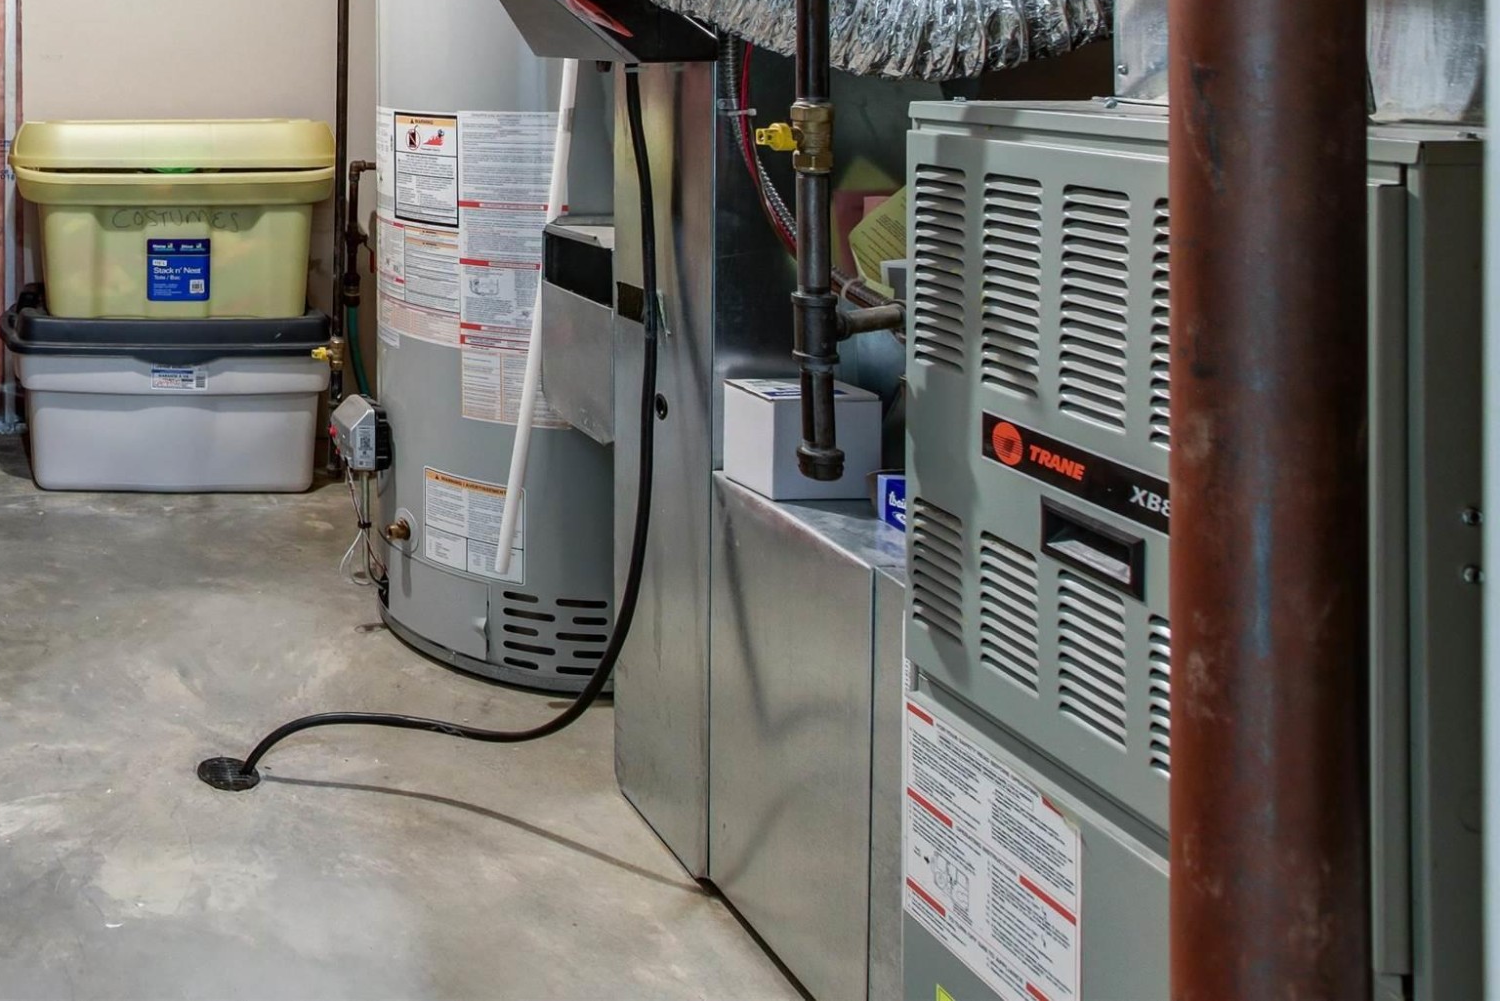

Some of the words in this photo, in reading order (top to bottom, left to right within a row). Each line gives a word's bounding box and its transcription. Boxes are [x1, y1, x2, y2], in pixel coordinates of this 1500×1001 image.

[112, 208, 239, 233] COSTUMES
[153, 266, 175, 275] Stack
[1029, 444, 1086, 482] TRANE
